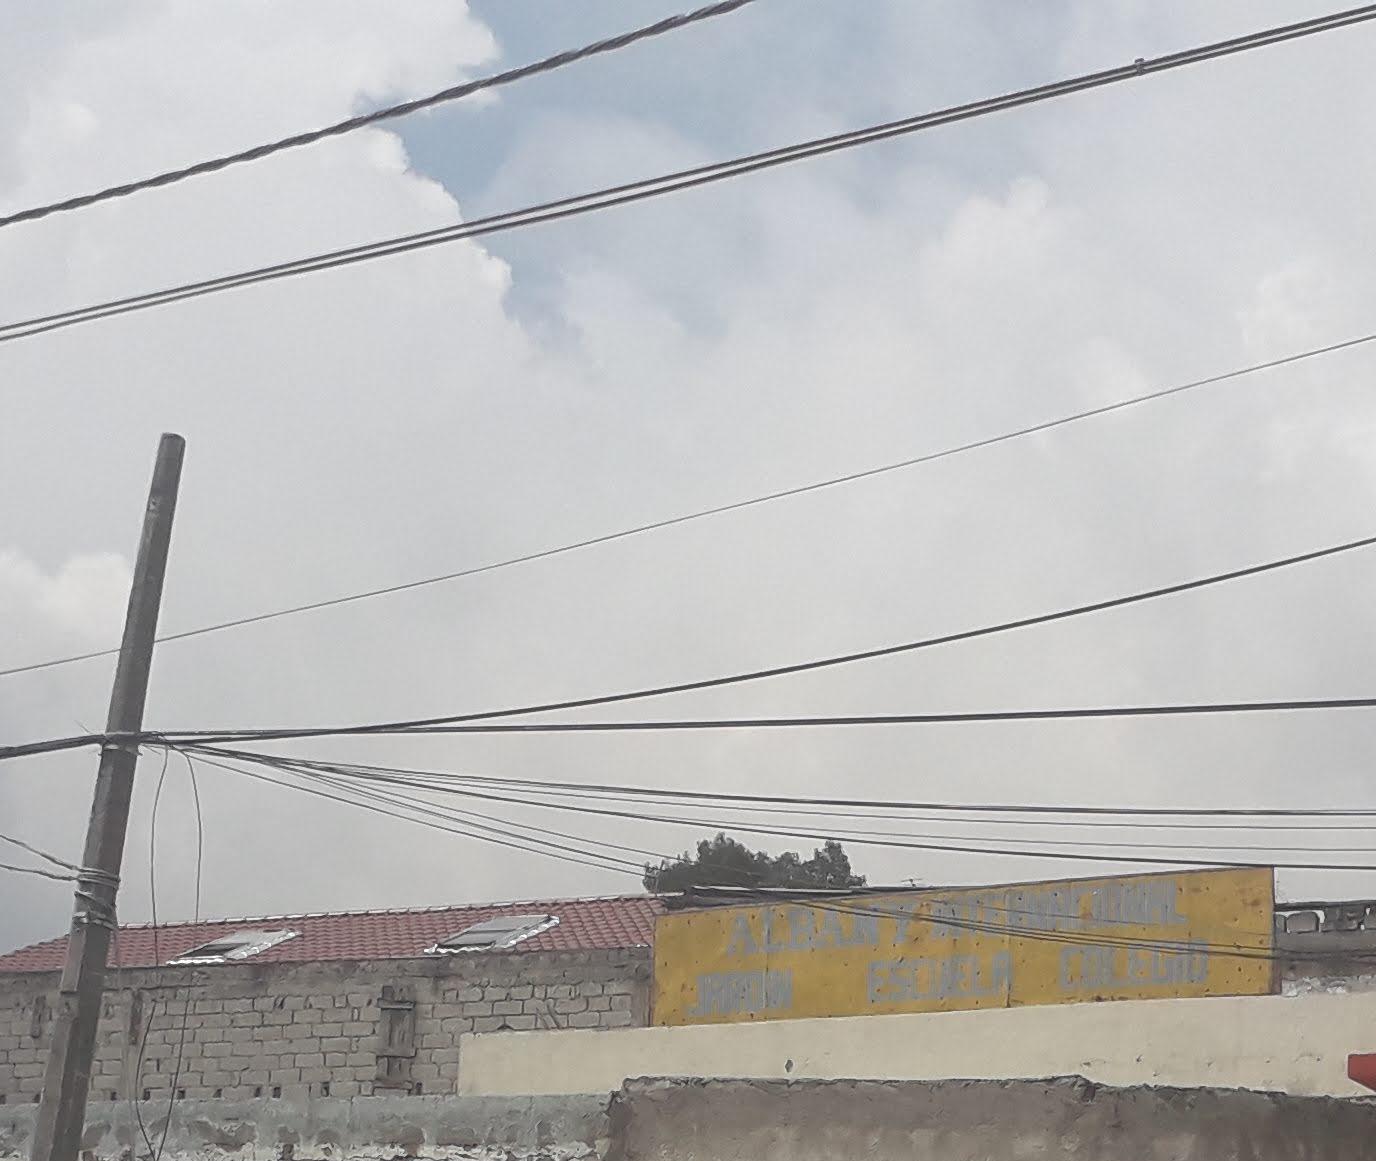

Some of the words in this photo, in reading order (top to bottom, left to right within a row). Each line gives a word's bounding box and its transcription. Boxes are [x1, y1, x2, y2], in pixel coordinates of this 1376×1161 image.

[724, 902, 920, 957] ALBANY
[867, 951, 1013, 1004] ESCUELA
[1058, 938, 1210, 992] COLEGIO
